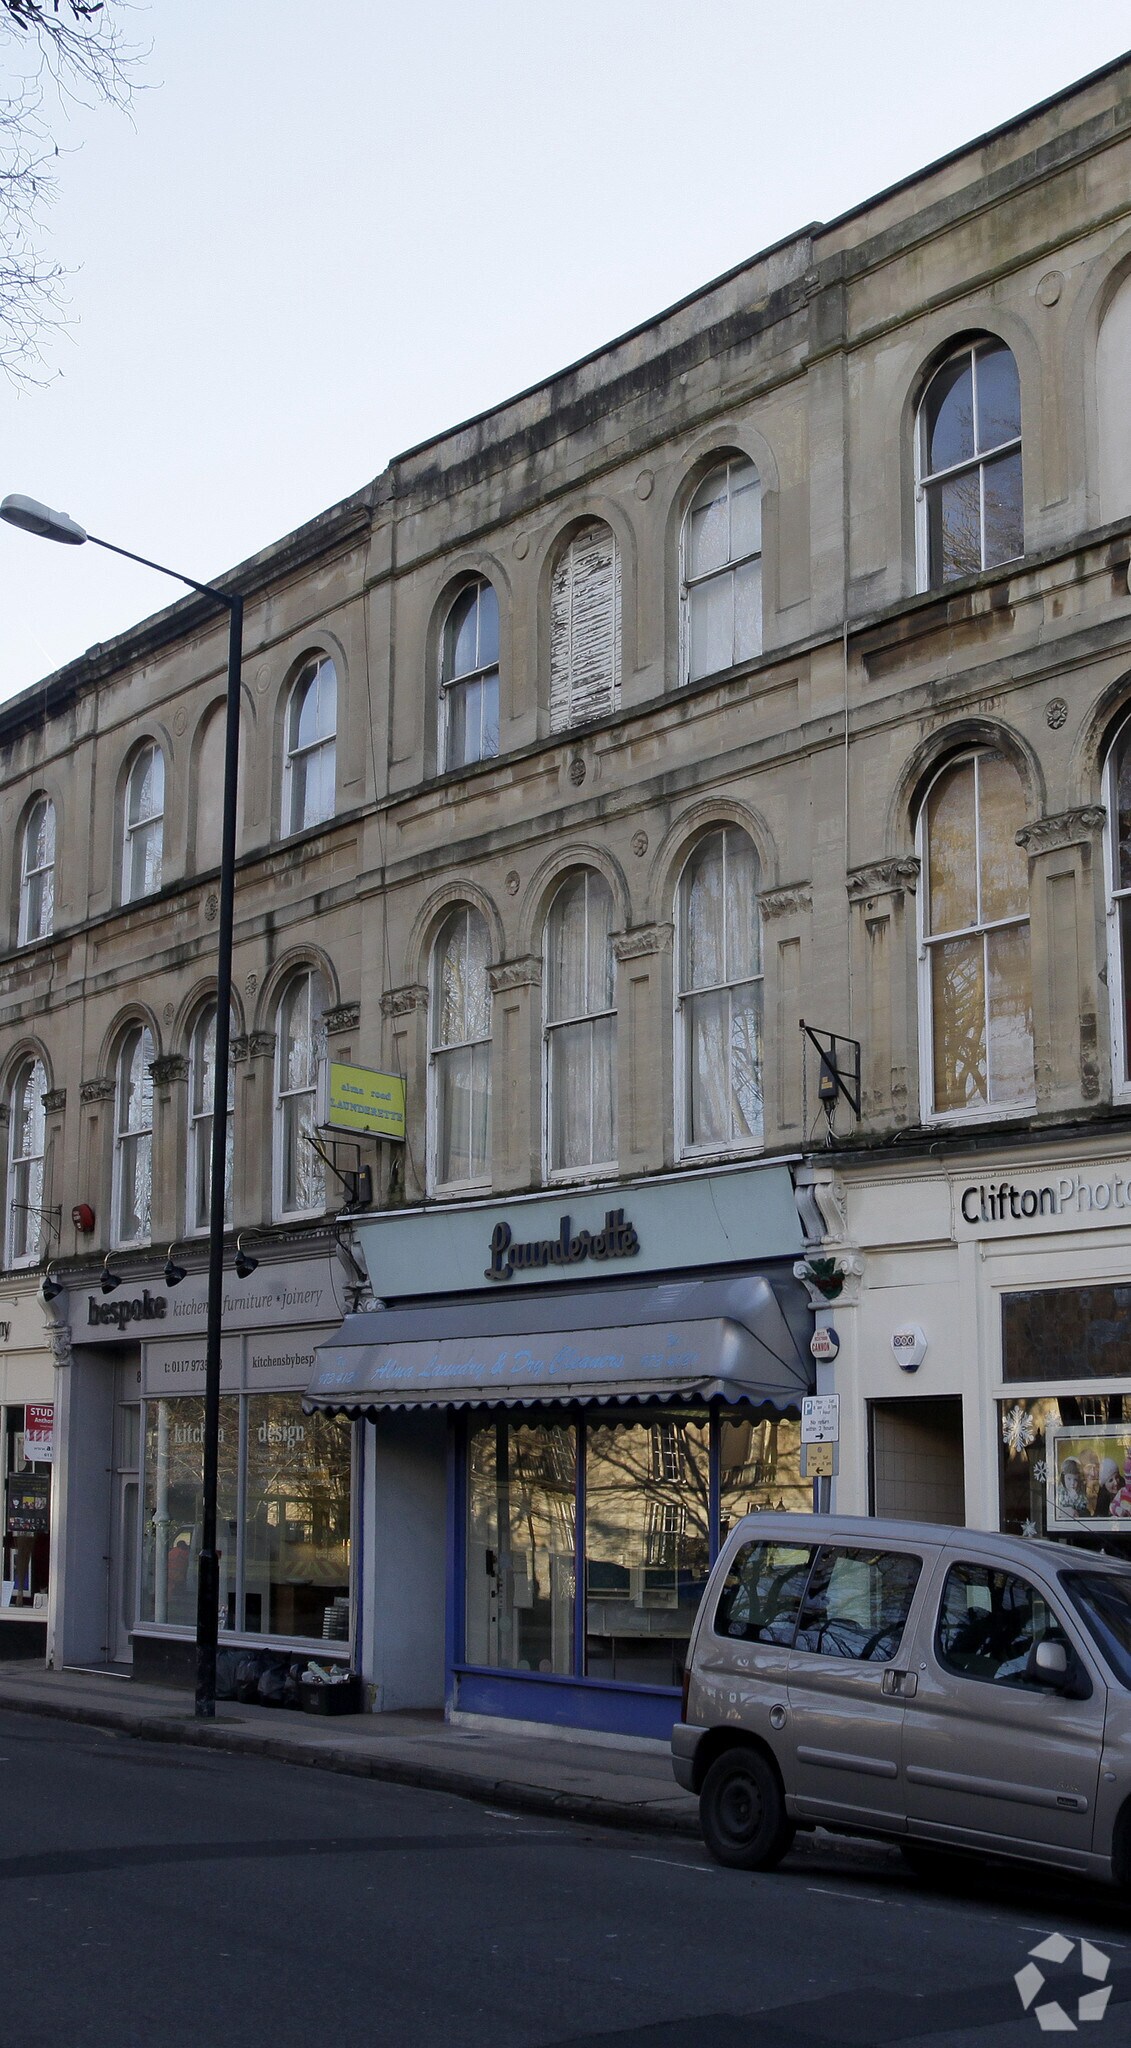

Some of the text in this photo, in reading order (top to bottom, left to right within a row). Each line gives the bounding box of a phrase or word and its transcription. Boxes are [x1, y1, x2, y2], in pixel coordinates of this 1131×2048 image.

[330, 1097, 403, 1122] LAUNDERETTE
[484, 1208, 640, 1281] Launderette
[87, 1288, 168, 1331] bespoke
[221, 1293, 273, 1316] furniture
[281, 1288, 323, 1310] joinery
[172, 1361, 189, 1373] 0117
[252, 1353, 315, 1368] kitchensbybesp
[370, 1358, 416, 1380] Alma
[418, 1354, 486, 1380] Laundry
[511, 1350, 545, 1376] Dry
[549, 1345, 624, 1375] Cleaners
[174, 1420, 305, 1449] kitchn design
